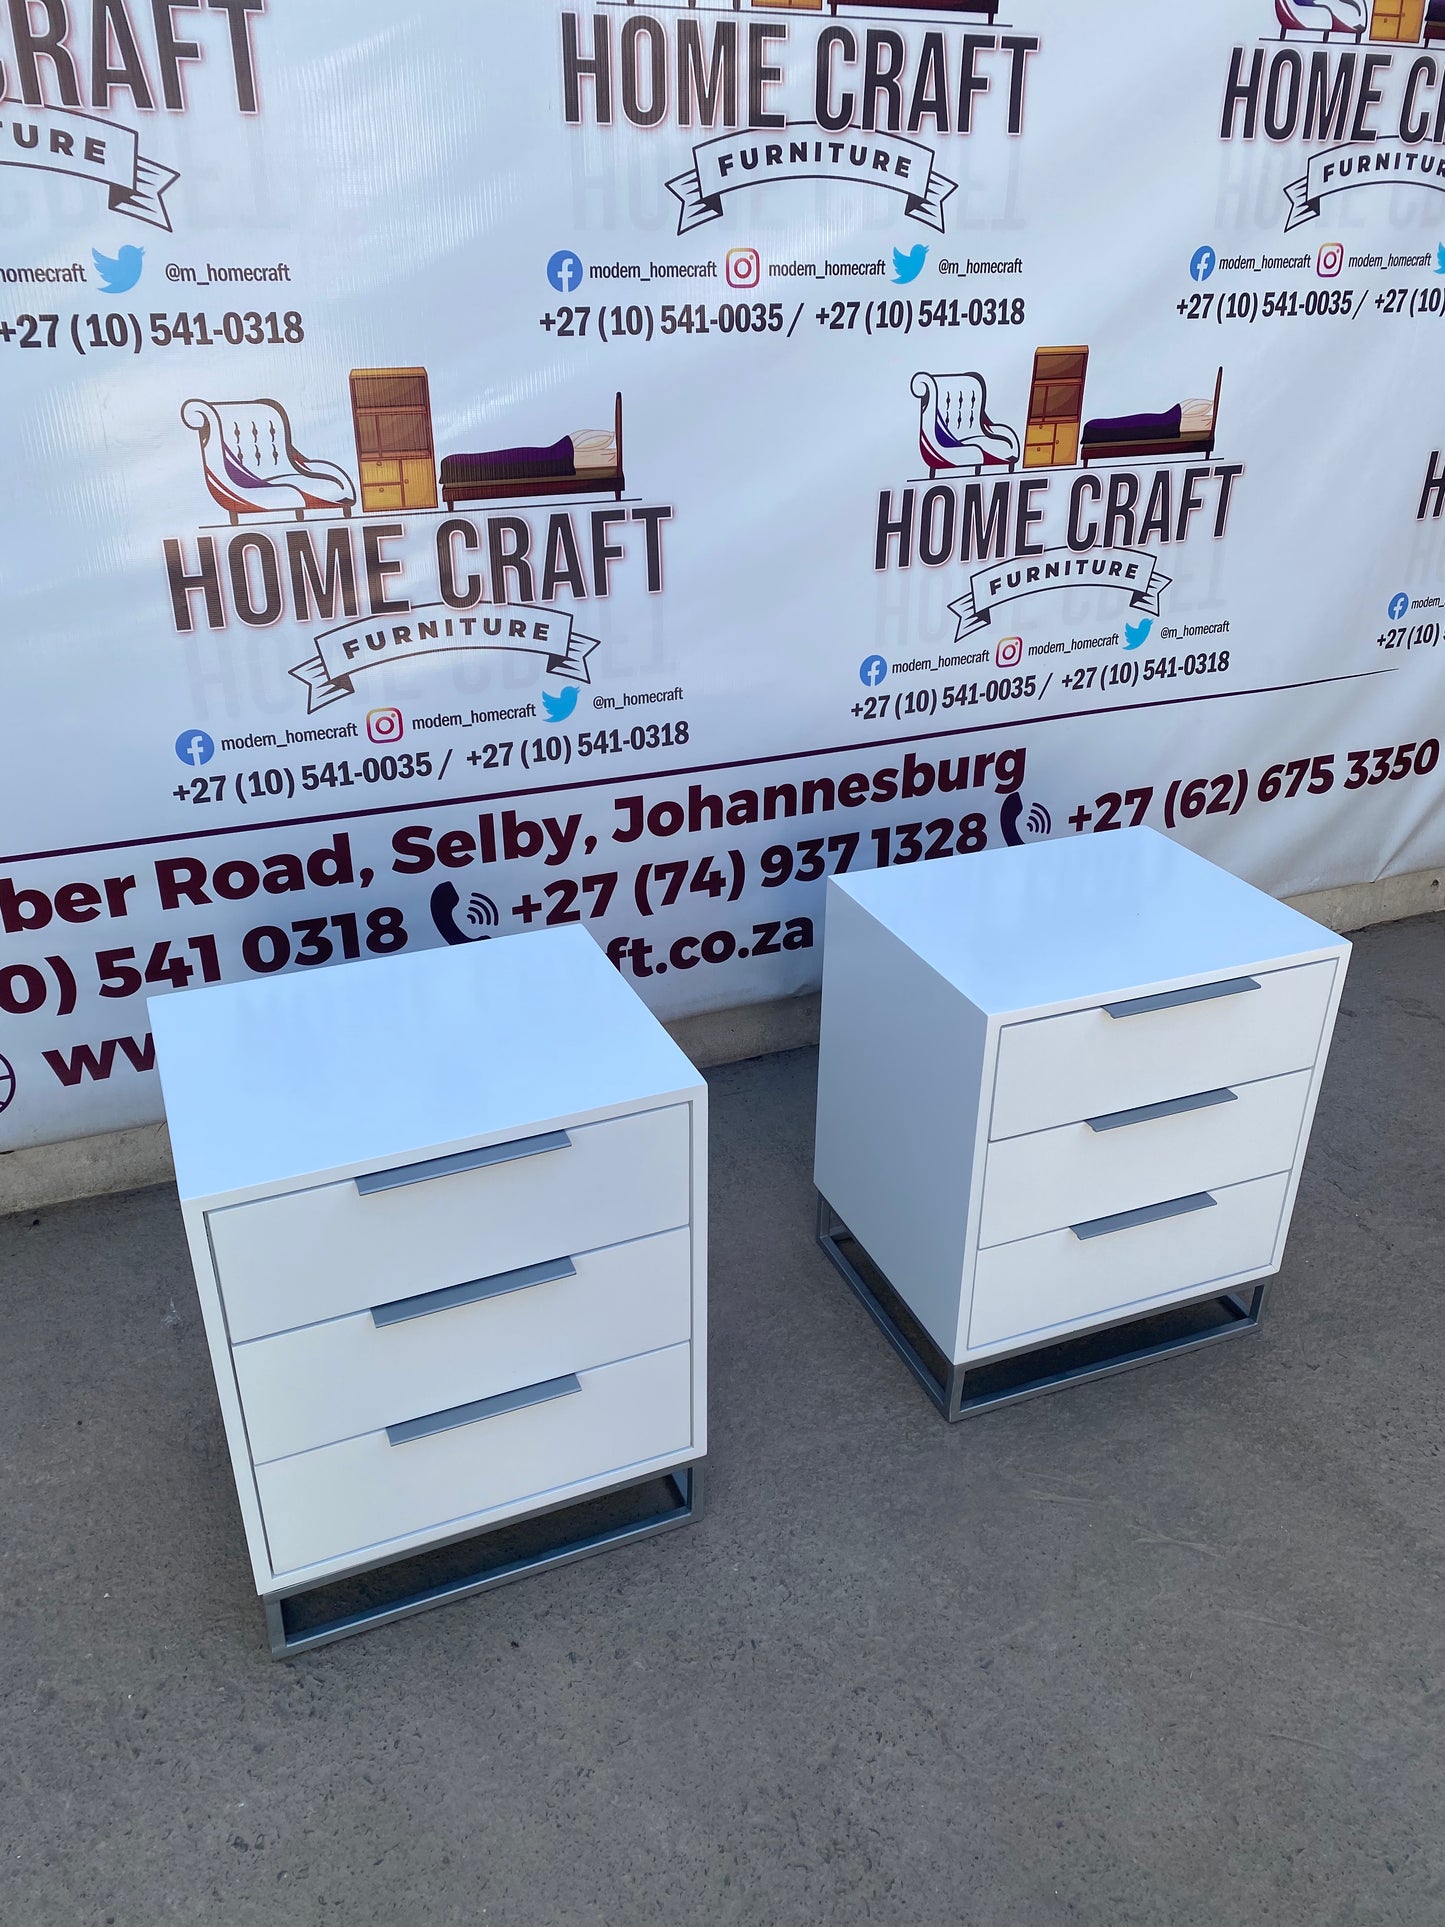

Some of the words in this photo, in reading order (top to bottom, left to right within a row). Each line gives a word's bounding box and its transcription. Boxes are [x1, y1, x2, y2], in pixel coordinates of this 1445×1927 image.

[0, 0, 267, 114] RAFT
[562, 10, 788, 128] HOME
[813, 24, 1040, 135] CRAFT
[1219, 46, 1393, 142] HOME
[0, 122, 106, 165] URE
[718, 141, 913, 180] FURNITURE
[165, 263, 291, 285] @m_homecraft
[938, 258, 1023, 276] @m_homecraft
[539, 306, 591, 338] +27
[598, 305, 653, 342] (10)
[660, 303, 783, 335] 541-0035
[815, 300, 861, 330] +27
[864, 300, 913, 334] (10)
[918, 297, 1026, 328] 541-0318
[1176, 293, 1215, 320] +27
[1216, 292, 1259, 325] (10)
[1262, 290, 1353, 318] 541-0035
[1374, 288, 1409, 314] +27
[70, 313, 142, 355] (10)
[149, 310, 305, 346] 541-0318
[876, 479, 1049, 570] HOME
[1067, 464, 1244, 553] CRAFT
[163, 523, 410, 632] HOME
[436, 506, 673, 608] CRAFT
[989, 559, 1140, 596] FURNITURE
[1411, 596, 1445, 610] modern_
[342, 617, 550, 660] FURNITURE
[1160, 620, 1231, 640] @m_homecraft
[1377, 627, 1408, 650] +27
[1407, 622, 1440, 651] (10)
[593, 687, 684, 710] @m_homecraft
[851, 694, 892, 720] +27
[894, 688, 938, 720] (10)
[941, 674, 1037, 709] 541-0035
[1061, 667, 1098, 691] +27
[1100, 661, 1139, 691] (10)
[1142, 650, 1230, 682] 541-0318
[173, 775, 227, 805] +27
[235, 768, 296, 805] (10)
[302, 751, 433, 791] 541-0035
[466, 742, 514, 769] +27
[520, 735, 572, 770] (10)
[577, 720, 690, 757] 541-0318
[1067, 786, 1155, 834] +27
[1164, 768, 1249, 830] (62)
[1257, 753, 1336, 803] 675
[1343, 737, 1441, 790] 3350
[154, 832, 376, 911] Road,
[392, 813, 600, 876] Selby,
[611, 746, 1027, 845] Johannesburg
[511, 871, 619, 926] +27
[634, 850, 746, 917] (74)
[760, 832, 860, 887] 937
[871, 812, 988, 868] 1328
[95, 934, 222, 999] 541
[241, 906, 409, 974] 0318
